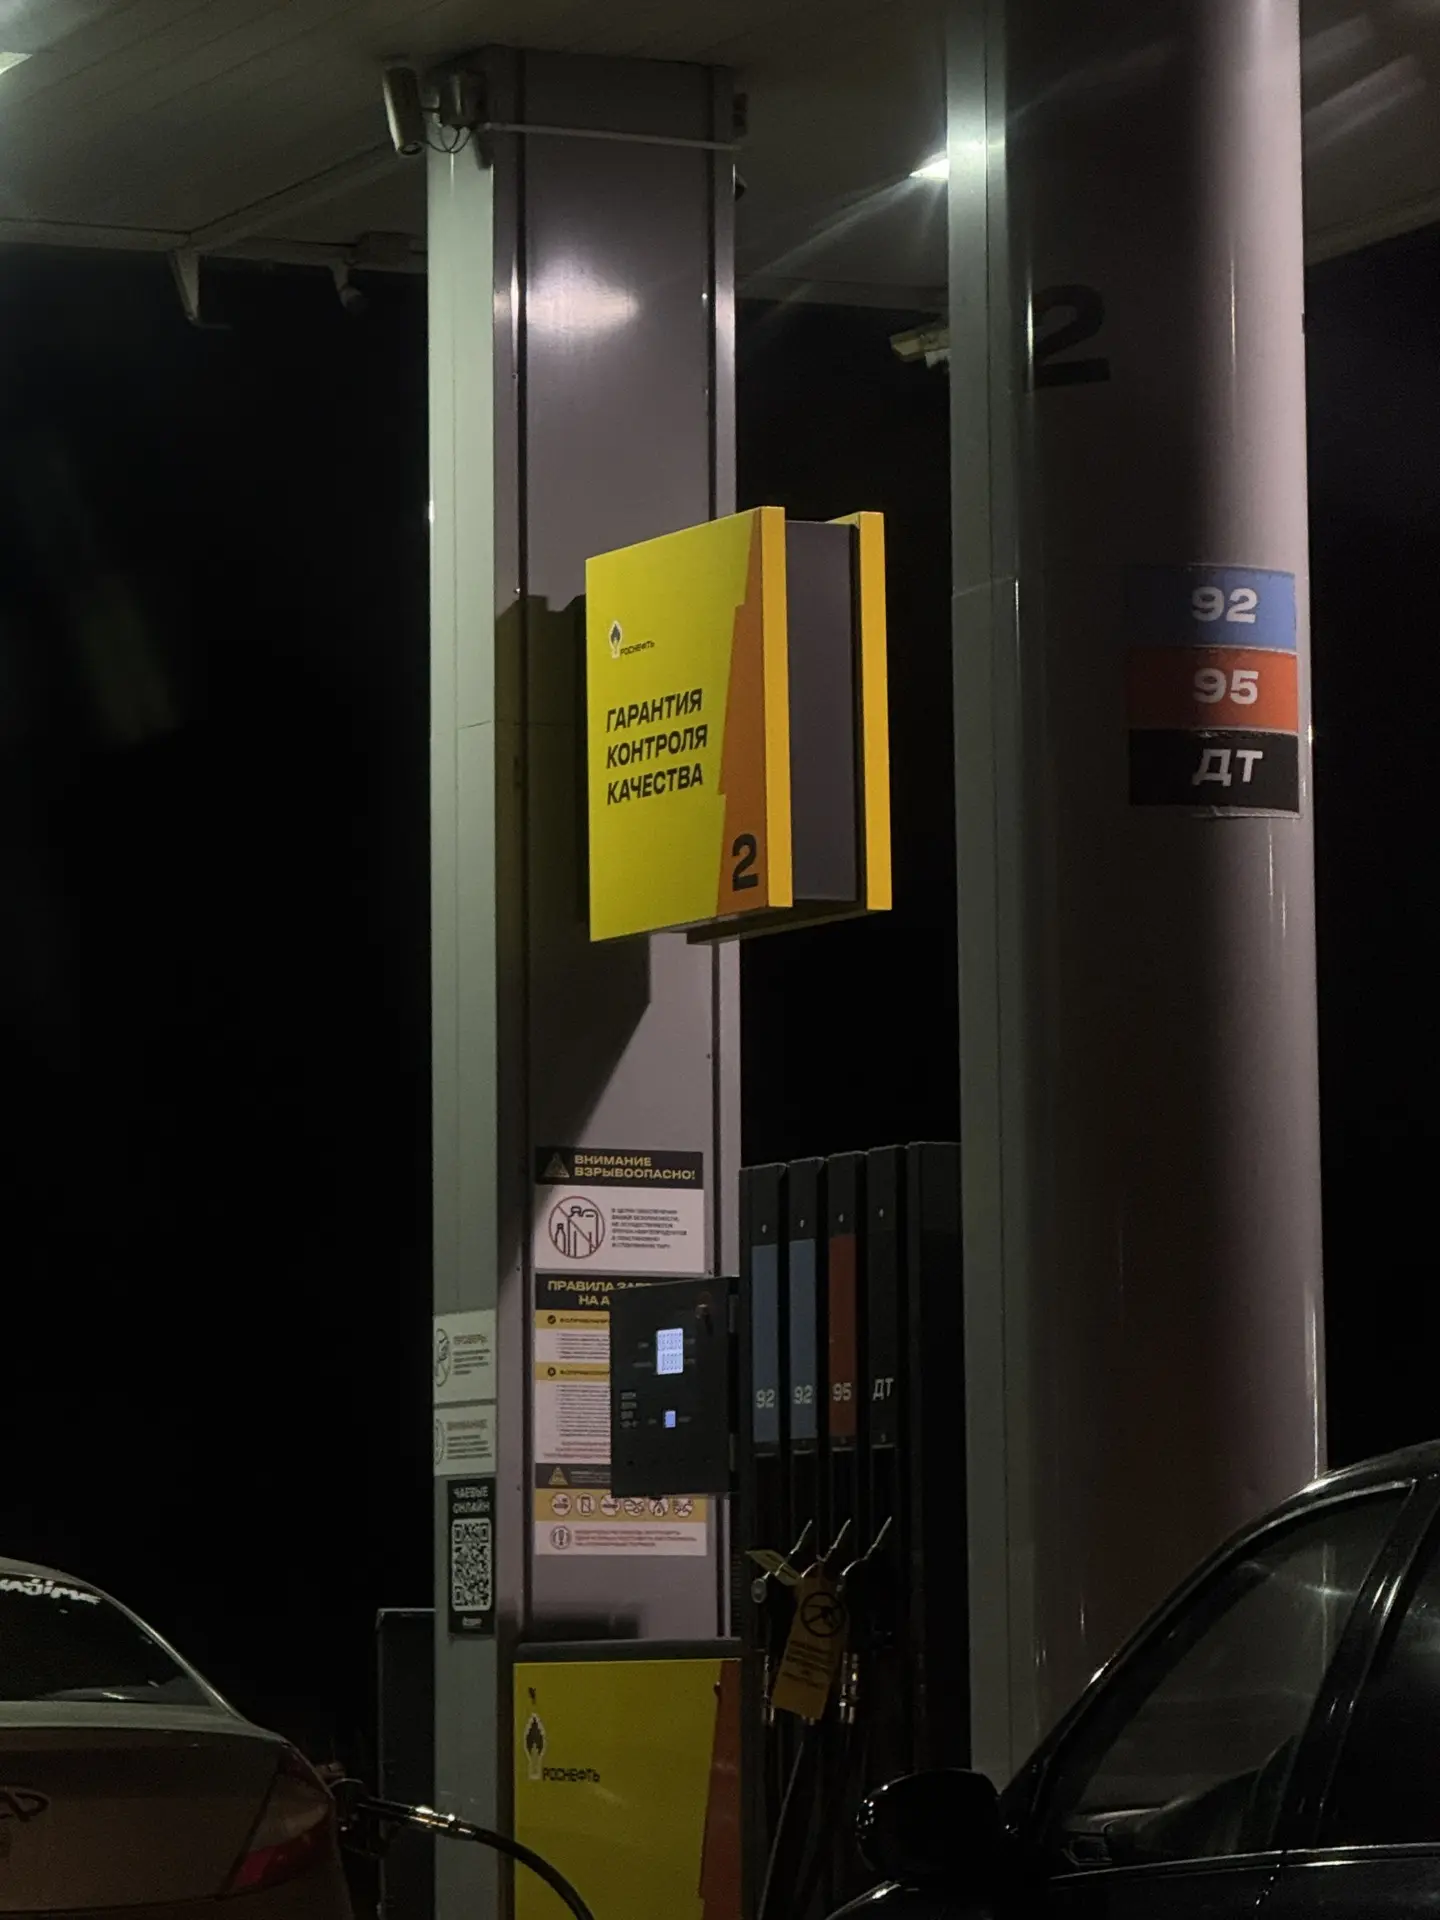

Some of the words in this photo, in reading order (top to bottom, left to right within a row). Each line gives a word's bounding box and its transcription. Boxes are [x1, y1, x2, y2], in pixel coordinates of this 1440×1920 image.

[1022, 284, 1111, 391] 2
[1191, 585, 1258, 624] 92
[619, 640, 655, 656] РОСНЕФТЬ
[1192, 667, 1259, 705] 95
[606, 688, 703, 733] ГАРАНТИЯ
[606, 724, 708, 769] КОНТРОЛЯ
[1191, 748, 1263, 787] ДТ
[606, 763, 704, 806] КАЧЕСТВА
[731, 833, 760, 893] 2
[574, 1154, 652, 1167] ВНИМАНИЕ
[574, 1167, 696, 1181] ВЗРЫВООПАСНО!
[547, 1280, 614, 1292] ПРАВИЛА
[578, 1294, 598, 1306] НА
[755, 1389, 775, 1408] 92
[793, 1385, 813, 1404] 92
[832, 1382, 852, 1402] 95
[872, 1377, 894, 1401] ДТ
[542, 1767, 600, 1783] РОСНЕФТЬ
